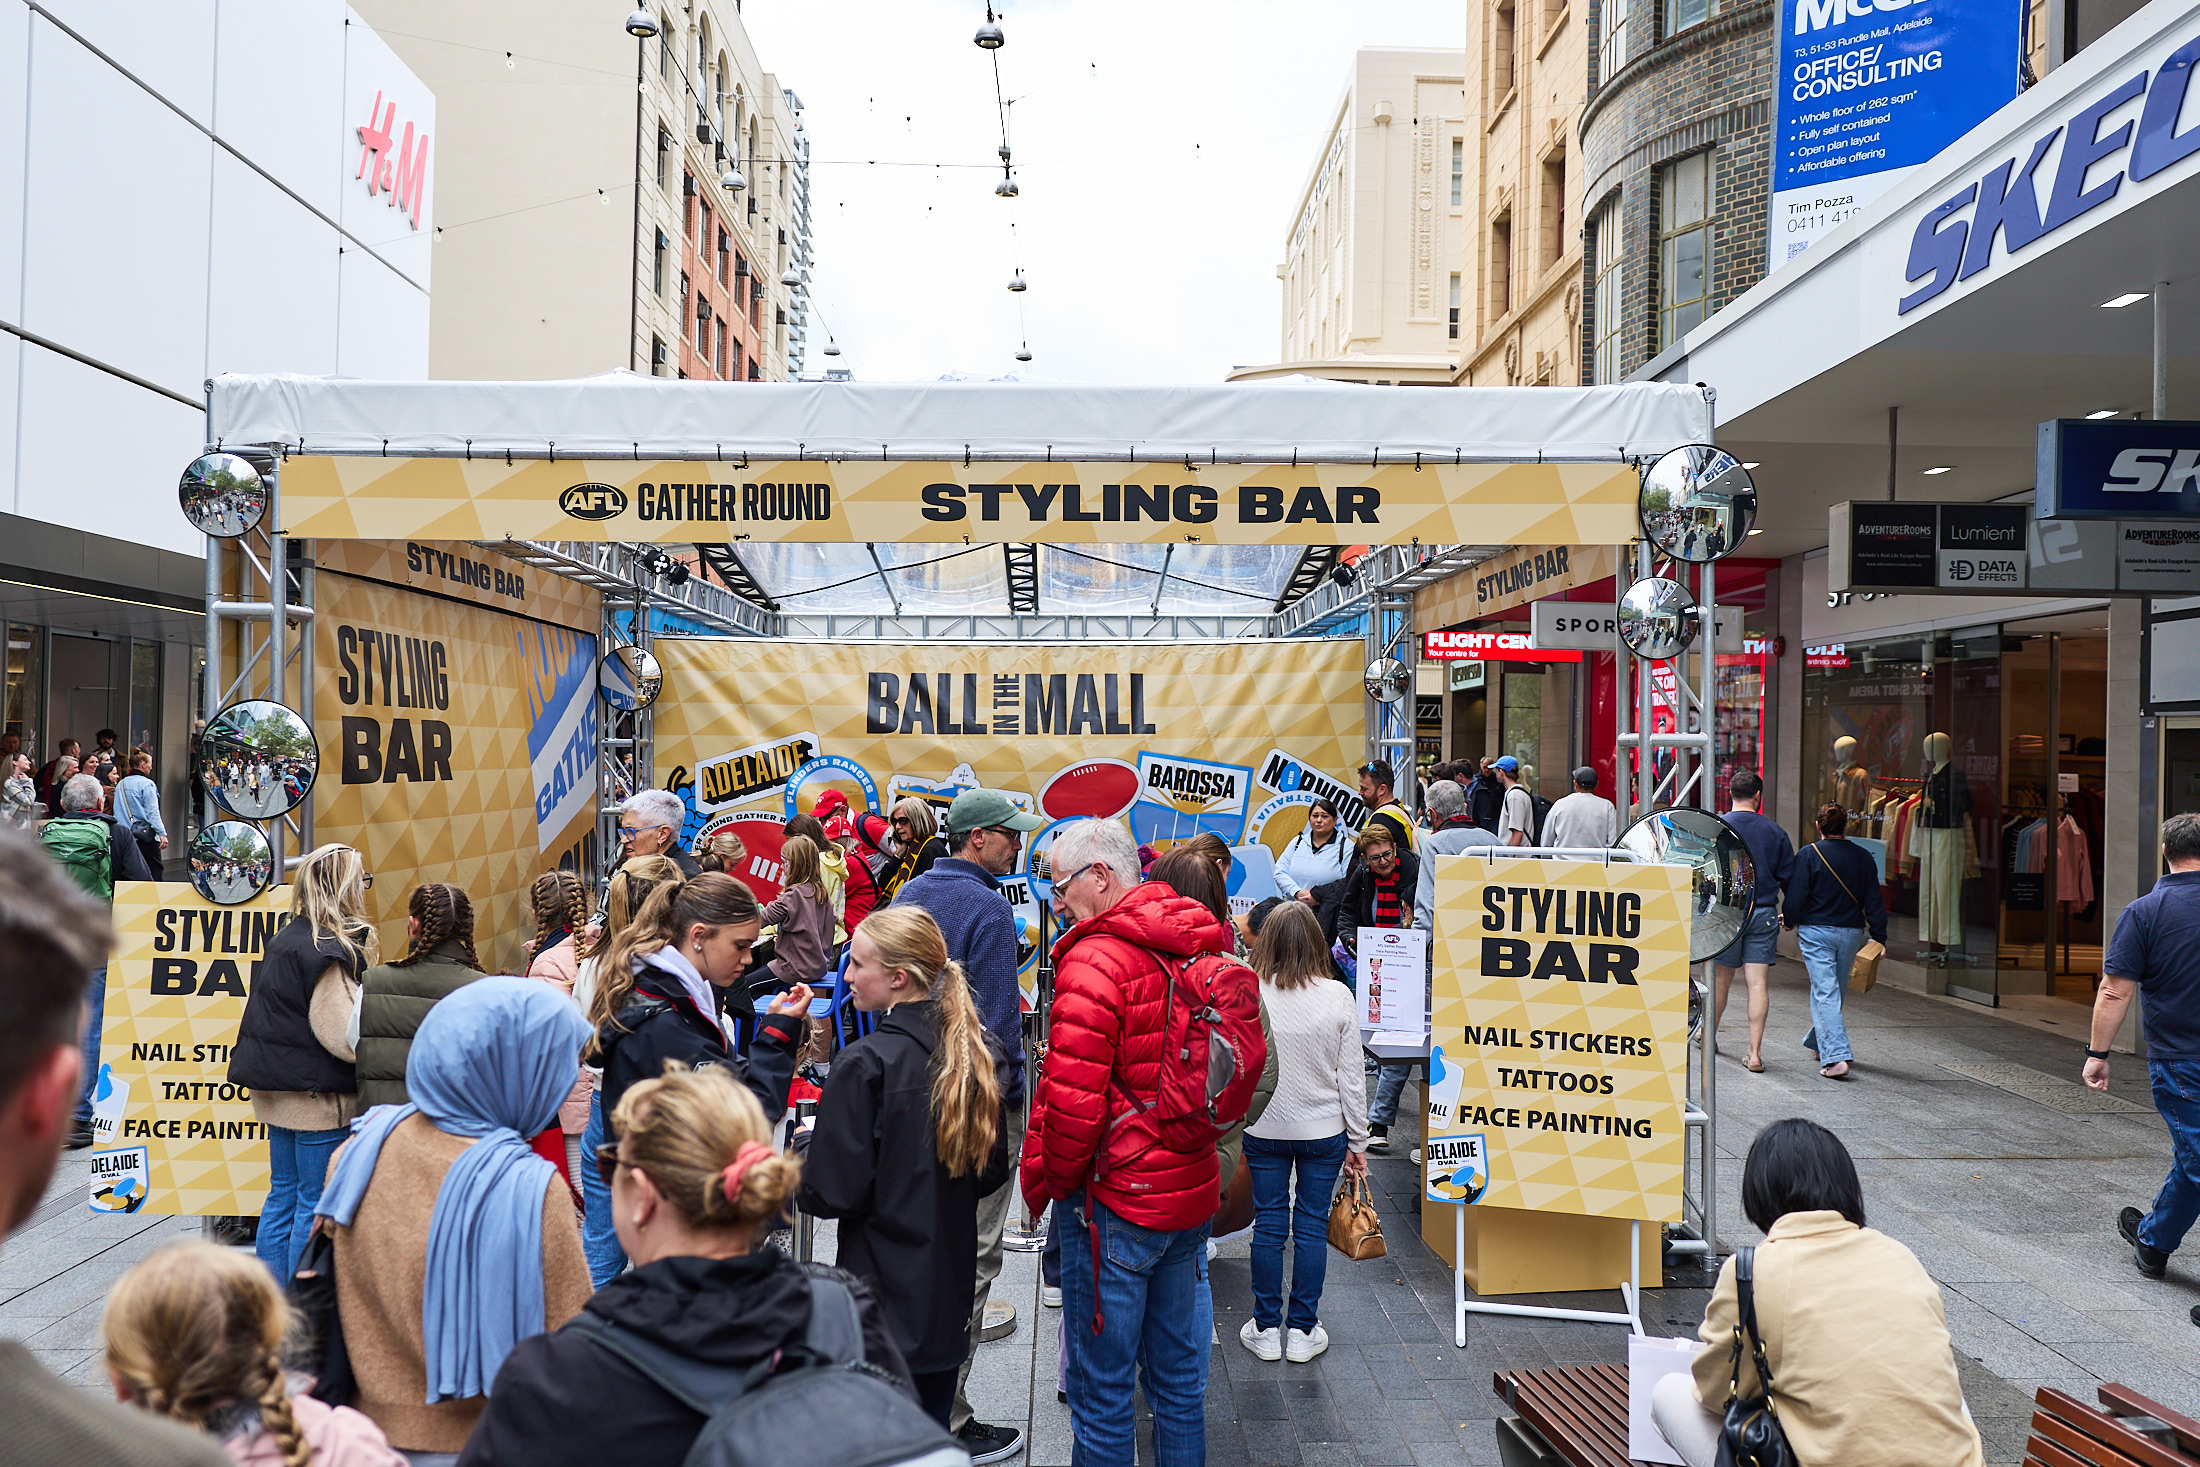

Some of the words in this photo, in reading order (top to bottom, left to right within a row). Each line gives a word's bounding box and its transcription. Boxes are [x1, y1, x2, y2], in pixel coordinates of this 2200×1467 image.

[1794, 49, 1808, 58] T3,
[1810, 41, 1836, 55] 51-53
[1838, 33, 1869, 47] Rundle
[1870, 26, 1891, 39] Mall,
[1892, 16, 1933, 33] Adelaide
[1792, 51, 1942, 102] CONSULTING
[1793, 43, 1884, 82] OFFICE/
[1800, 111, 1830, 125] Whole
[1832, 105, 1854, 118] floor
[1856, 102, 1867, 113] of
[1868, 96, 1888, 110] 262
[1799, 128, 1821, 141] Fully
[1823, 124, 1840, 136] self
[1841, 113, 1891, 132] contained
[356, 90, 429, 230] H&M
[1797, 153, 1847, 173] Affordable
[1849, 147, 1886, 163] offering
[1798, 144, 1825, 159] Open
[1827, 139, 1849, 153] plan
[1850, 132, 1881, 147] layout
[1788, 203, 1811, 215] Tim
[1815, 195, 1853, 210] Pozza
[1787, 214, 1825, 233] 0411
[638, 483, 736, 521] GATHER
[743, 483, 830, 521] ROUND
[921, 483, 1219, 523] STYLING
[1238, 486, 1381, 524] BAR
[1951, 525, 2016, 541] Lumient
[406, 542, 490, 591] STYLING
[495, 569, 525, 600] BAR
[1477, 560, 1534, 603] STYLING
[1535, 546, 1570, 582] BAR
[1978, 560, 2017, 572] DATA
[1978, 573, 2018, 582] EFFECTS
[1428, 633, 1495, 649] FLIGHT
[1496, 634, 1534, 649] CEN
[1428, 649, 1443, 657] Your
[1445, 650, 1467, 658] centre
[1468, 650, 1479, 658] for
[337, 625, 449, 711] STYLING
[866, 672, 987, 735] BALL
[993, 673, 1019, 712] THE
[1024, 673, 1156, 735] MALL
[993, 714, 1019, 735] IN
[341, 715, 453, 785] BAR
[536, 685, 597, 825] GATHE
[701, 740, 803, 801] ADELAIDE
[787, 758, 829, 804] FLINDERS
[831, 758, 874, 794] RANGES
[1148, 763, 1236, 799] BAROSSA
[1172, 792, 1208, 805] PARK
[1257, 794, 1320, 821] USTRALIA
[1261, 754, 1367, 833] NRWOO
[701, 816, 733, 837] ROUND
[1481, 885, 1641, 939] STYLING
[154, 908, 291, 954] STYLIN
[1384, 935, 1400, 943] AFL
[1480, 937, 1640, 986] BAR
[131, 1042, 187, 1062] NAIL
[1231, 1034, 1245, 1080] macpac
[1463, 1025, 1523, 1048] NAIL
[1530, 1029, 1652, 1057] STICKERS
[161, 1081, 251, 1102] TATTOO
[1497, 1067, 1614, 1094] TATTOOS
[124, 1119, 181, 1139] FACE
[187, 1120, 270, 1140] PAINTI
[1459, 1105, 1520, 1128] FACE
[1527, 1110, 1652, 1138] PAINTING
[91, 1153, 139, 1174] DELAIDE
[1428, 1141, 1478, 1160] DELAIDE
